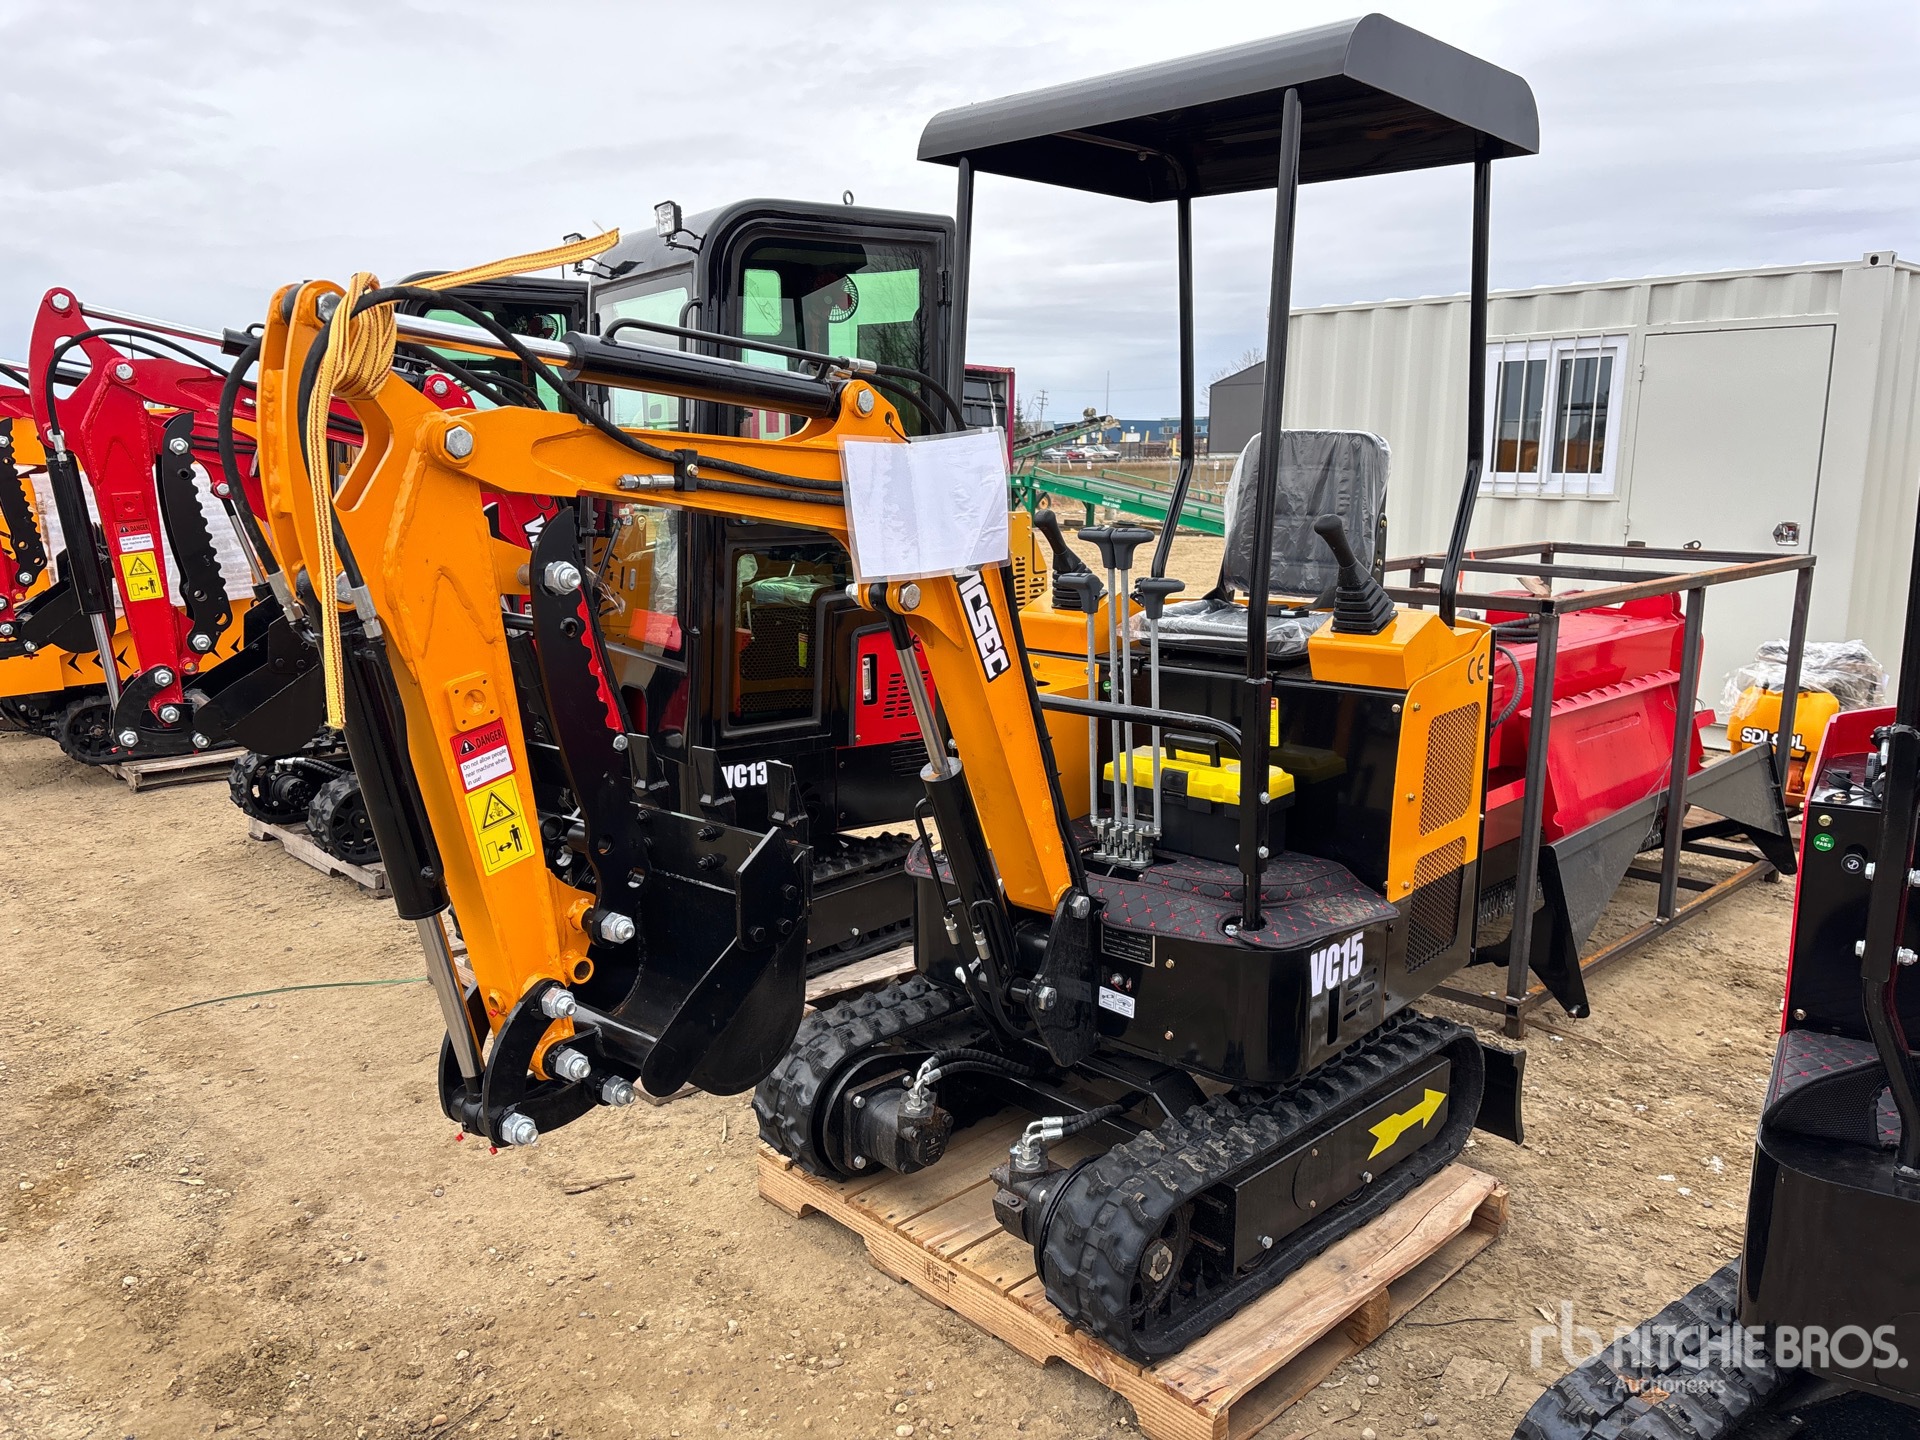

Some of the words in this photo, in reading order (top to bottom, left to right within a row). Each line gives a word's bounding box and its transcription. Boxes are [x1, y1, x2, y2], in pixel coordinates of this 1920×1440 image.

[1467, 652, 1485, 685] CE
[475, 728, 503, 748] DANGER
[476, 762, 495, 773] machine
[495, 756, 507, 765] when
[479, 754, 491, 763] allow
[491, 748, 507, 759] people
[1815, 840, 1832, 848] PASS
[1310, 931, 1364, 998] VC15
